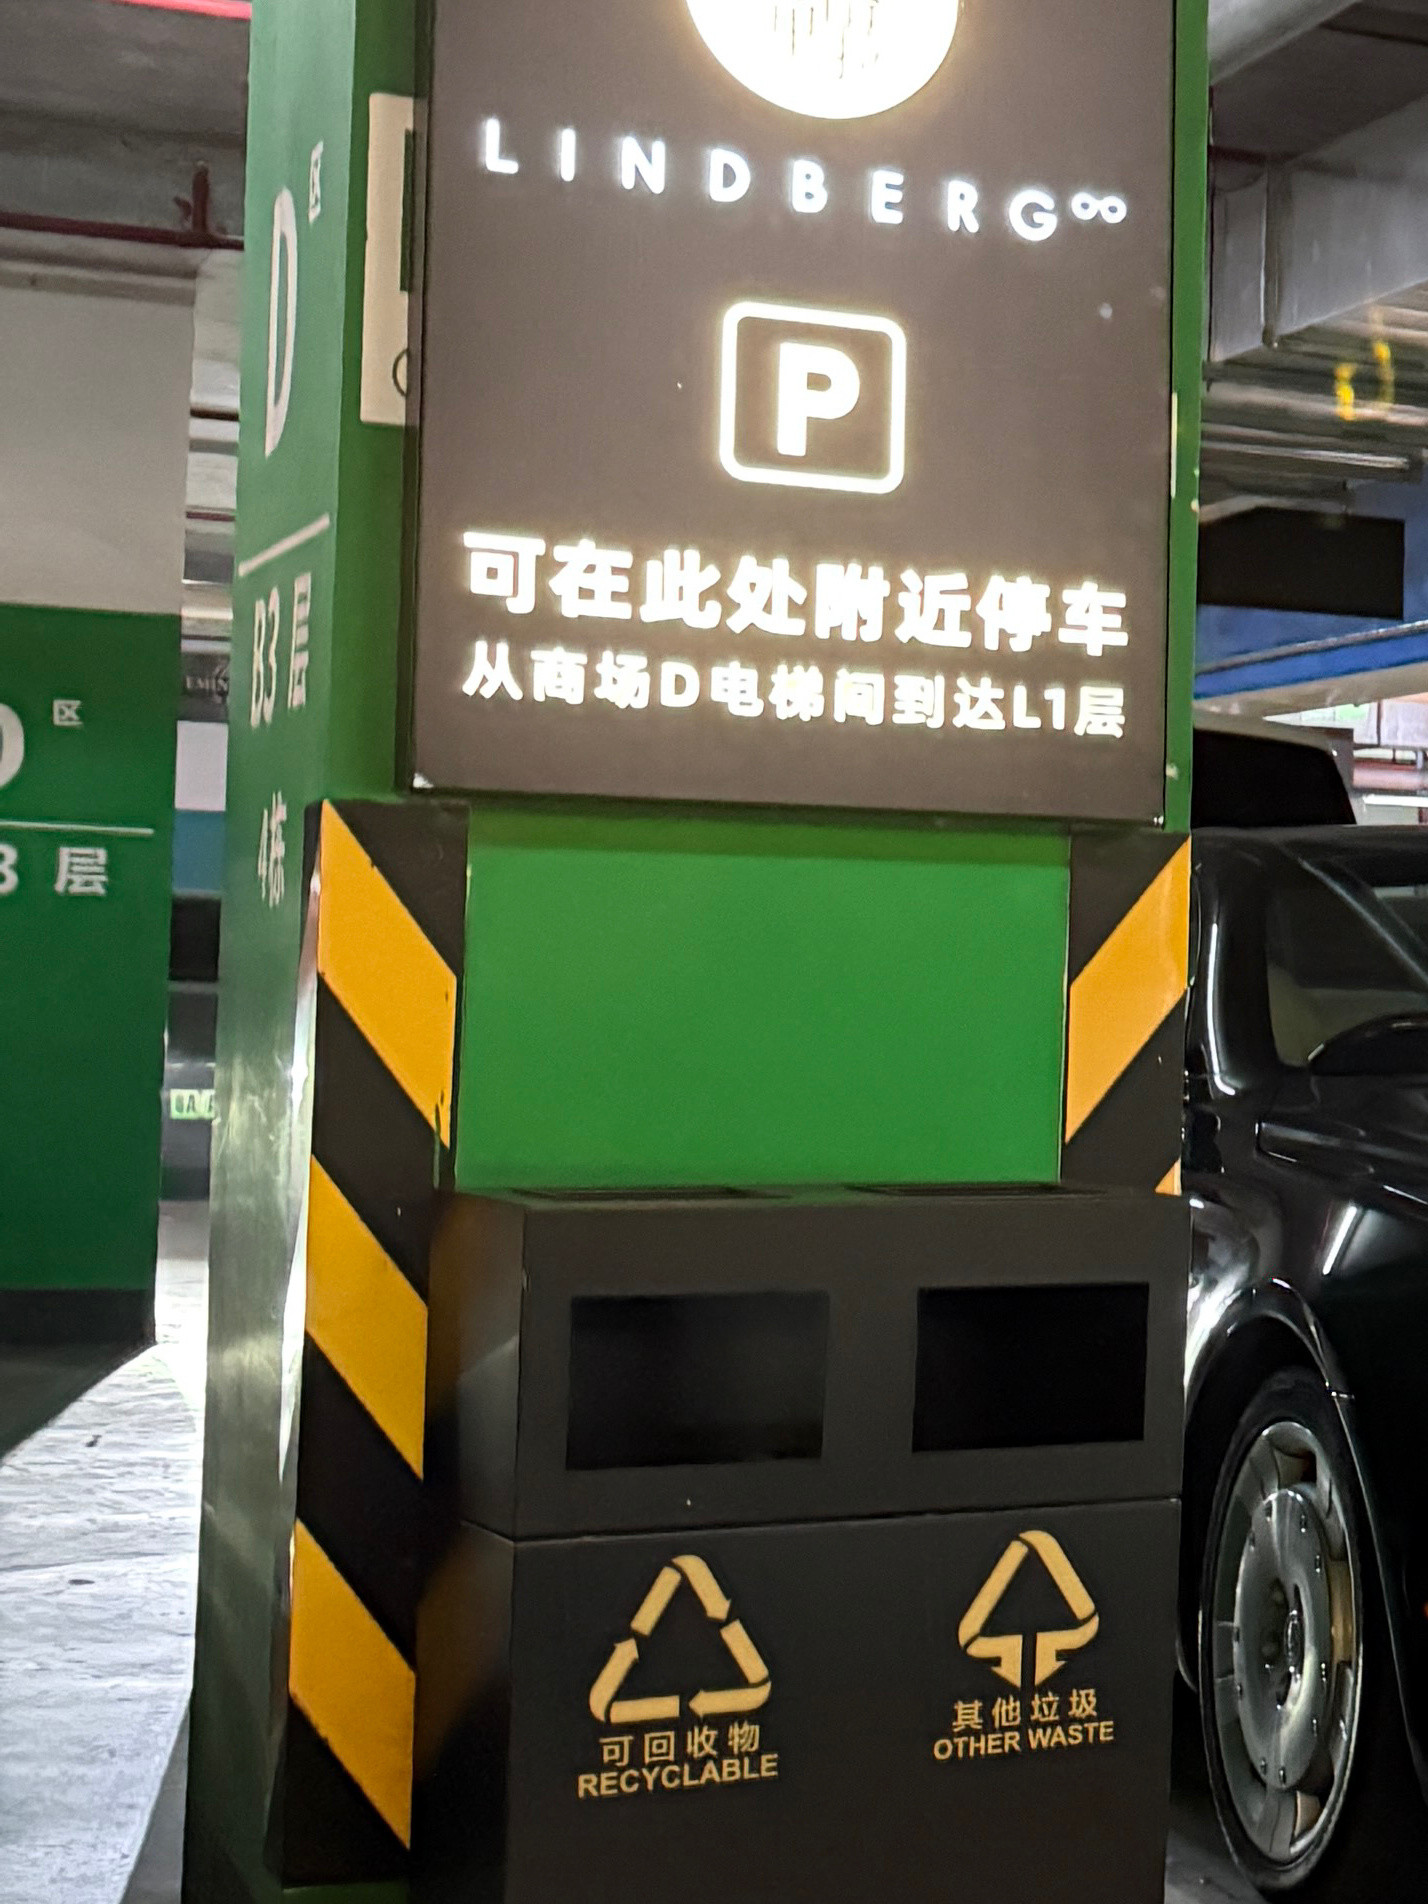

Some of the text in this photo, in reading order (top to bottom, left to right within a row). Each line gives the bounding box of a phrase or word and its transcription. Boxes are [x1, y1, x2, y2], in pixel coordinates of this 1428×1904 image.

[777, 341, 861, 456] P
[463, 530, 1129, 656] 可在此处附近停车
[462, 639, 1125, 739] 从商场D电梯间到达L1层
[952, 1688, 1097, 1732] 其他垃圾
[600, 1720, 761, 1766] 可回收物
[933, 1720, 1114, 1761] OTHER WASTE
[577, 1753, 779, 1798] RECYCLABLE
